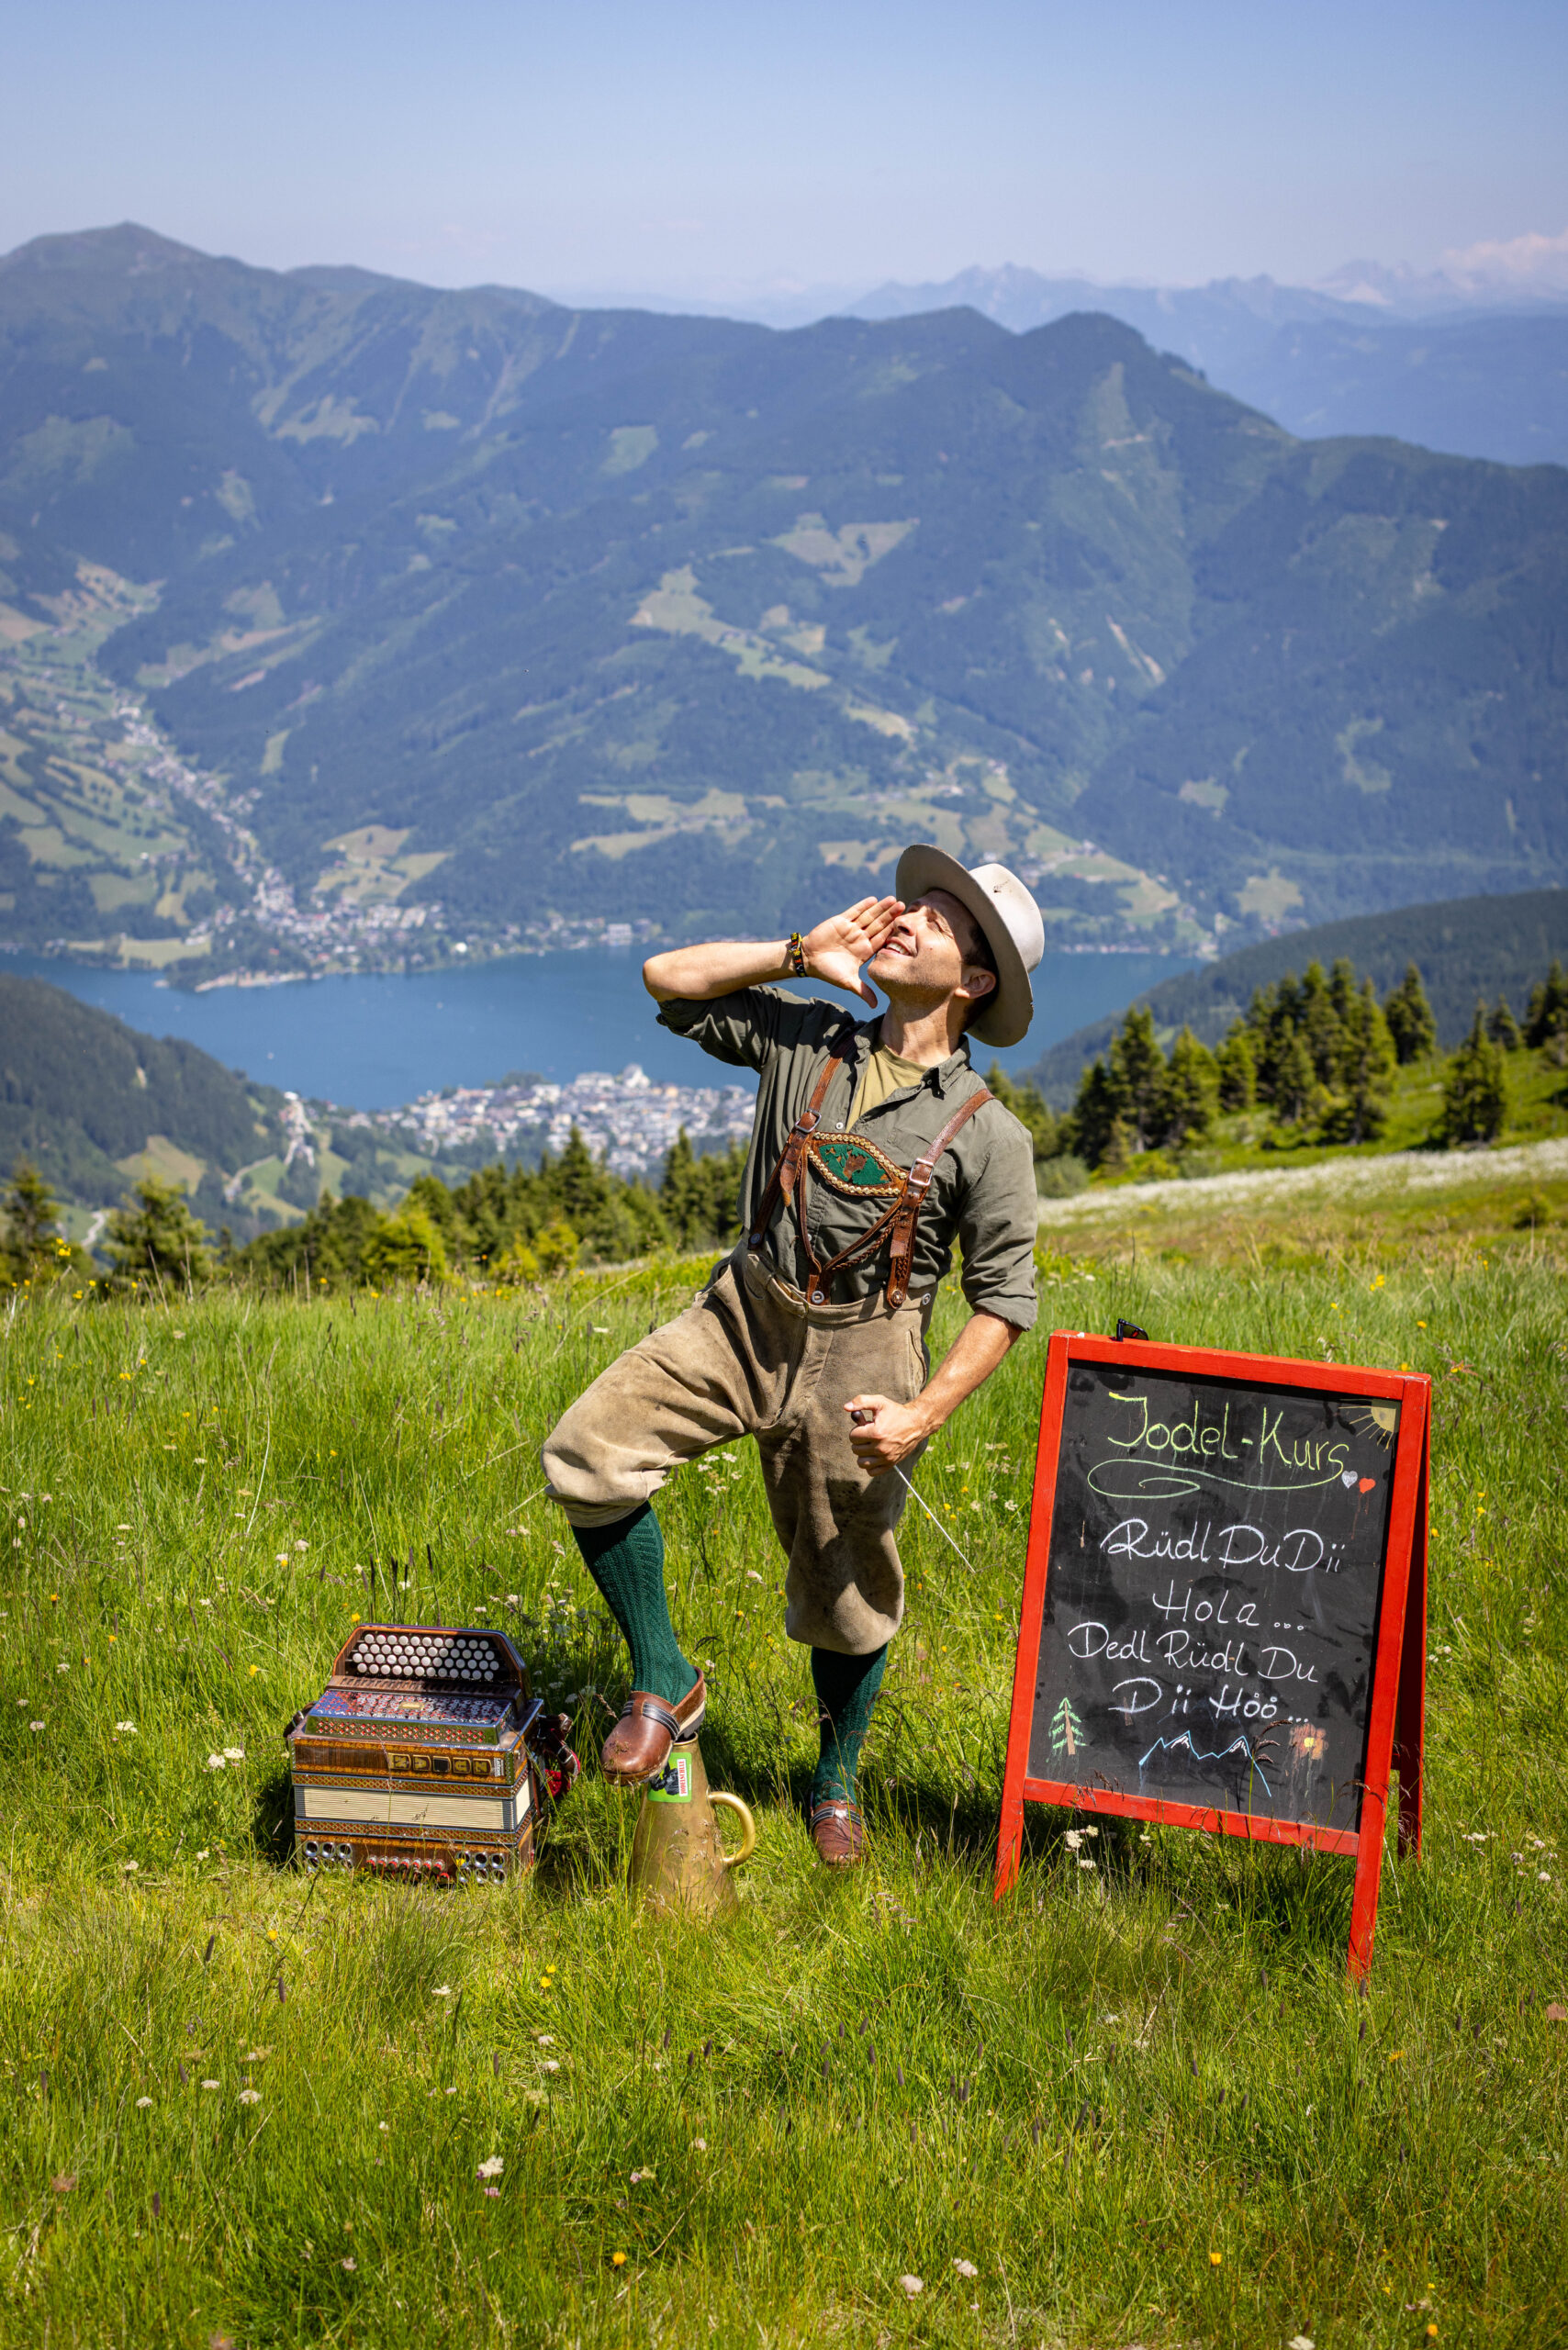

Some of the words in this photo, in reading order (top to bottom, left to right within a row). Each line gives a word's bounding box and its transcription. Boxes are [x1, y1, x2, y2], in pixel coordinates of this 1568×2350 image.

[1107, 1391, 1350, 1472] Jodel-Kurs
[1100, 1518, 1212, 1562] Rüdl
[1067, 1621, 1152, 1663] Dedl
[1156, 1629, 1249, 1676] Rüdl
[1257, 1646, 1319, 1683] Du
